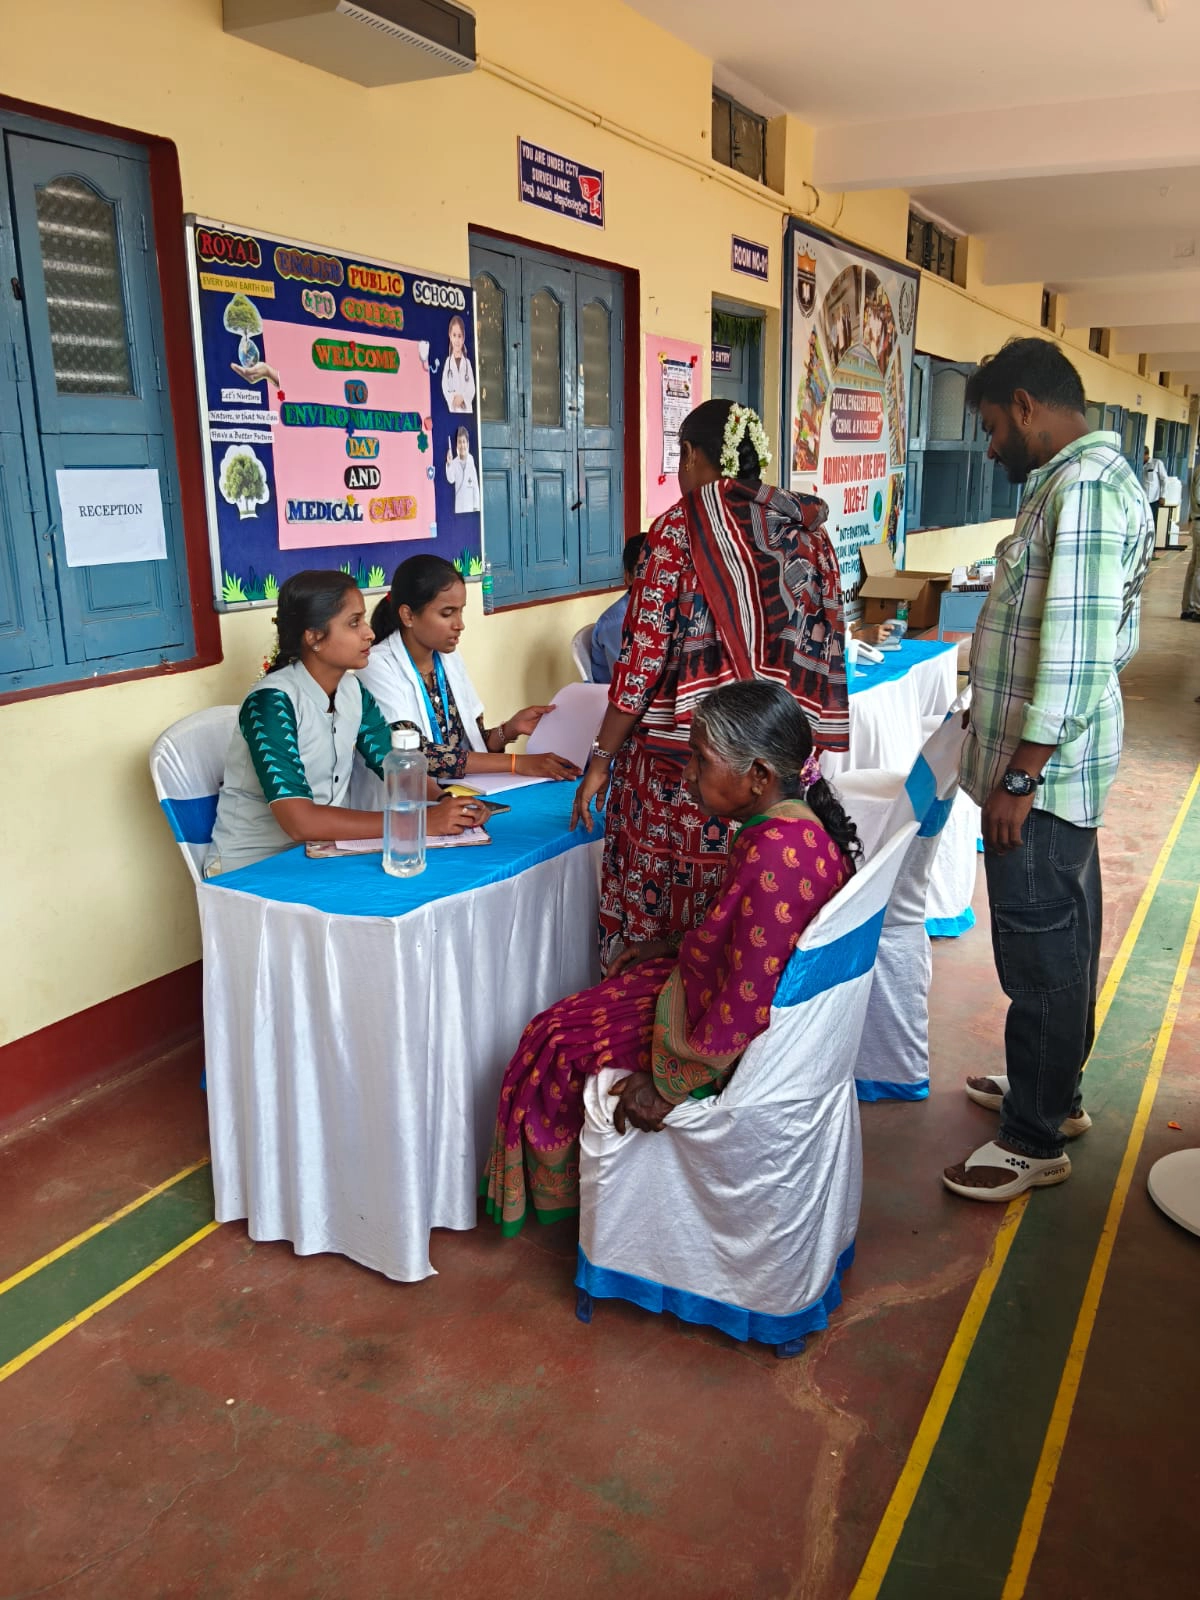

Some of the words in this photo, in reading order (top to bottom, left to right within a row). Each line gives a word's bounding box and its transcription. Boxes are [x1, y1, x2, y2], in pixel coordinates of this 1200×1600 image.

[522, 144, 534, 160] YOU
[534, 149, 546, 165] ARE
[546, 154, 565, 172] UNDER
[565, 162, 579, 178] CCTV
[531, 167, 571, 194] SURVEILLANCE
[734, 244, 751, 268] ROOM
[200, 233, 259, 263] ROYAL
[279, 251, 340, 283] ENGLISH
[349, 267, 402, 295] PUBLIC
[415, 282, 464, 307] SCHOOL
[203, 277, 224, 287] EVERY
[225, 280, 238, 289] DAY
[240, 281, 260, 293] EARTH
[260, 284, 274, 294] DAY
[344, 301, 403, 328] COLLEGE
[315, 344, 399, 369] WELCOME
[715, 351, 730, 364] ENTRY
[346, 383, 368, 405] TO
[283, 403, 422, 431] ENVIRONMENTAL
[349, 437, 379, 457] DAY
[348, 467, 381, 487] AND
[823, 455, 862, 485] ADMISSIONS
[862, 453, 873, 480] ARE
[873, 452, 887, 479] OPEN
[78, 503, 143, 517] RECEPTION
[287, 500, 364, 522] MEDICAL
[369, 499, 413, 520] CAMP
[843, 485, 869, 515] 2026-27
[1044, 1167, 1065, 1176] SPORTS
